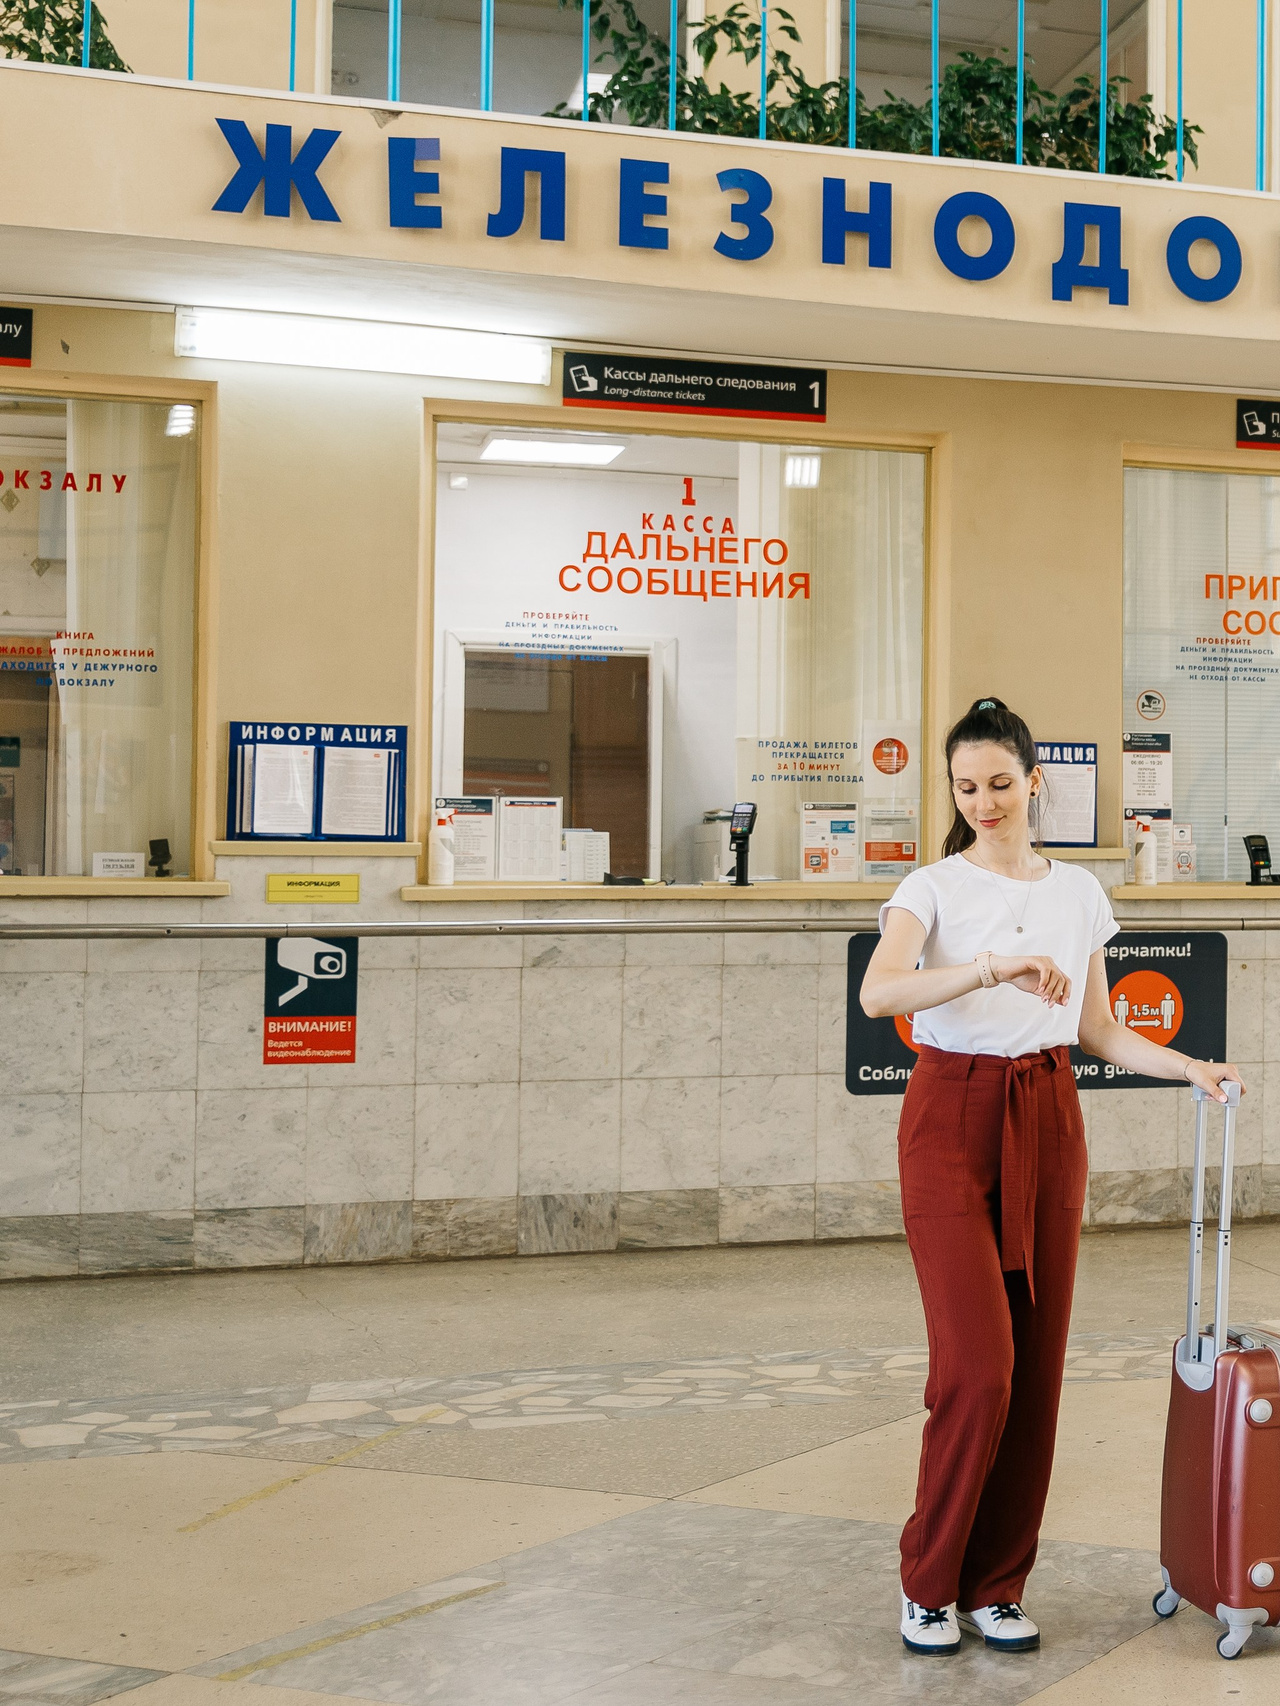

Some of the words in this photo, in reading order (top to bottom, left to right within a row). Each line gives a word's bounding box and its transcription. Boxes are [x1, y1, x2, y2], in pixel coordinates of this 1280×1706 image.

[603, 366, 647, 382] Кассы
[649, 371, 713, 387] дальнего
[716, 377, 797, 391] следования
[809, 381, 820, 408] 1
[604, 386, 673, 399] Long-distance
[675, 390, 706, 401] tickets
[0, 469, 127, 494] КЗАЛУ
[682, 477, 697, 506] 1
[642, 512, 736, 535] КАССА
[582, 531, 790, 566] ДАЛЬНЕГО
[558, 565, 811, 603] СООБЩЕНИЯ
[522, 610, 590, 621] ПРОВЕРЯЙТЕ
[554, 624, 619, 632] ПРАВИЛЬНОСТЬ
[56, 631, 94, 640] КНИГА
[1196, 636, 1252, 646] ПРОВЕРЯЙТЕ
[514, 642, 566, 650] ПРОЕЗДНЫХ
[0, 646, 42, 656] ЖАЛОБ
[49, 647, 56, 655] И
[63, 648, 155, 658] ПРЕДЛОЖЕНИЙ
[1202, 656, 1253, 664] ИНФОРМАЦИИ
[1, 662, 65, 671] АХОДИТСЯ
[72, 662, 78, 670] У
[84, 662, 158, 673] ДЕЖУРНОГО
[60, 678, 115, 688] ВОКЗАЛУ
[241, 724, 396, 743] ИНФОРМАЦИЯ
[758, 741, 808, 749] ПРОДАЖА
[772, 752, 845, 760] ПРЕКРАЩАЕТСЯ
[1038, 746, 1095, 763] МАЦИЯ
[793, 762, 805, 770] 10
[752, 774, 765, 782] ДО
[772, 774, 822, 782] ПРИБЫТИЯ
[1131, 1004, 1160, 1018] 1,5м
[268, 1020, 352, 1033] ВНИМАНИЕ!
[268, 1040, 303, 1048] Ведется
[268, 1048, 352, 1058] видеонаблюдение
